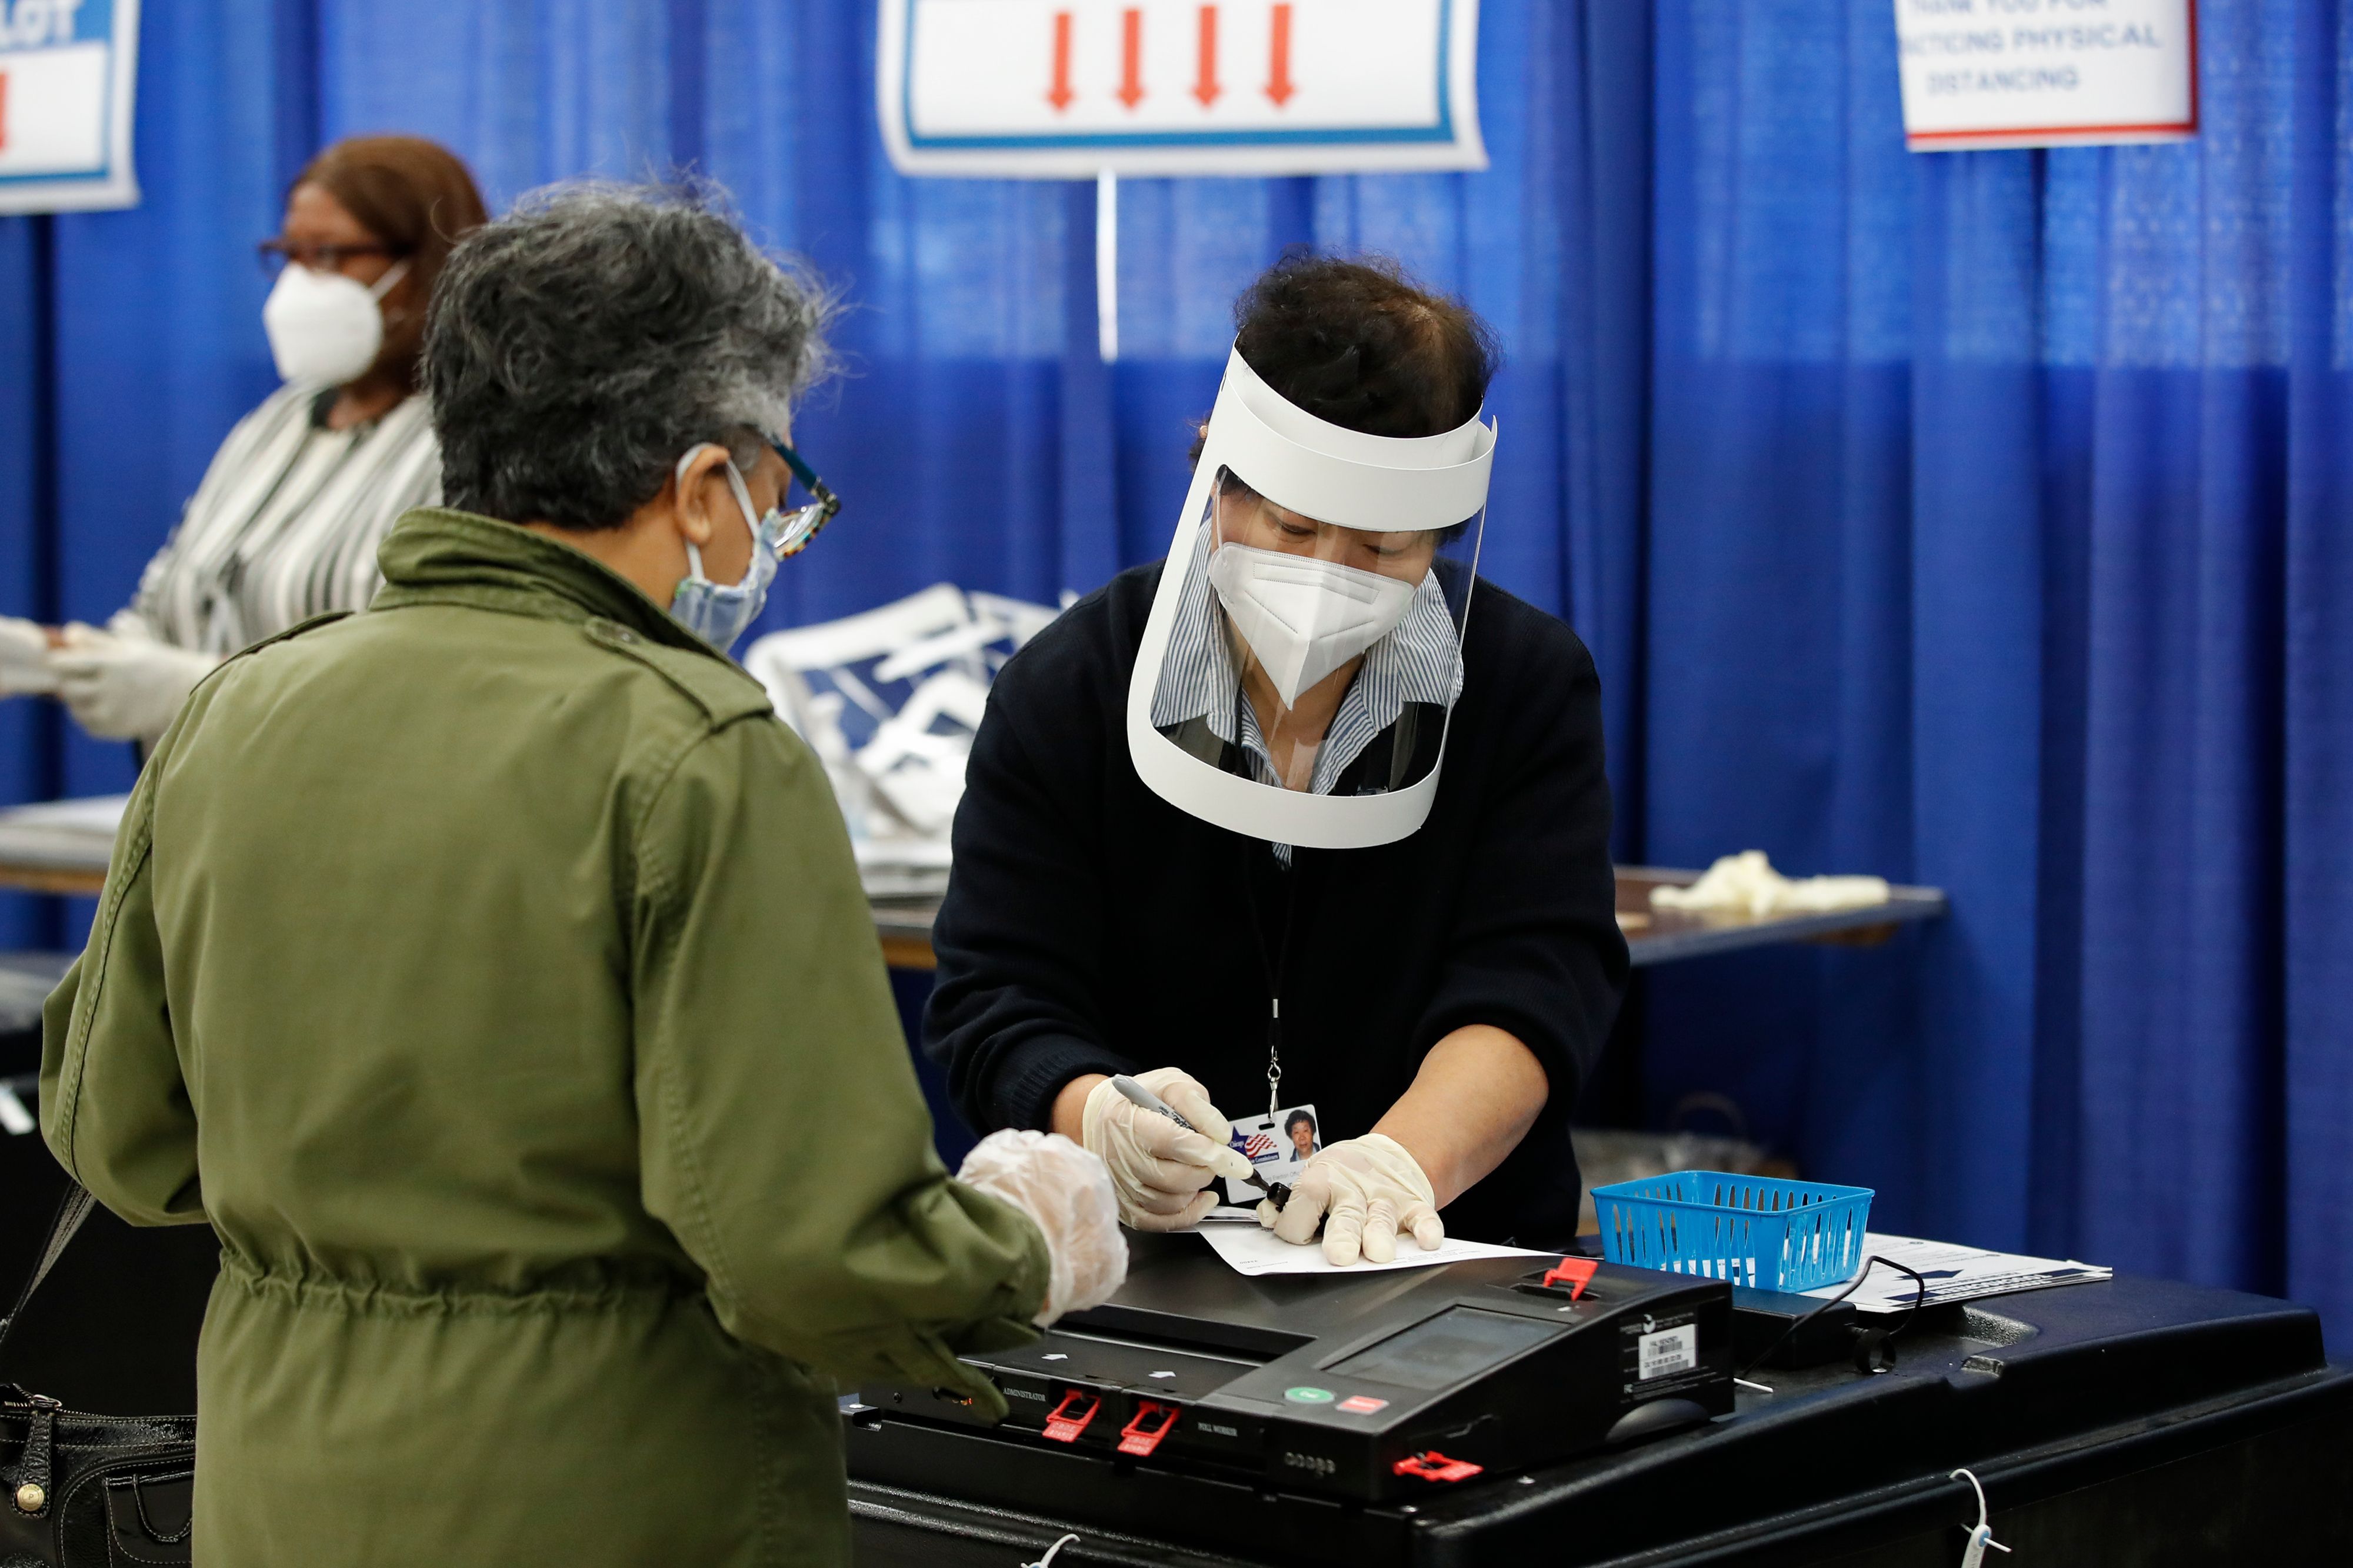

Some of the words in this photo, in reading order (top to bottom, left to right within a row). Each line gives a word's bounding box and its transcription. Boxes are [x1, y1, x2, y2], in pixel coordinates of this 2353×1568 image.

[2012, 22, 2166, 51] PHYSICAL
[1926, 66, 2081, 97] DISTANCING
[1928, 1274, 2053, 1295] TOUCHSCREEN
[1003, 1387, 1046, 1402] ADMINISTRATOR
